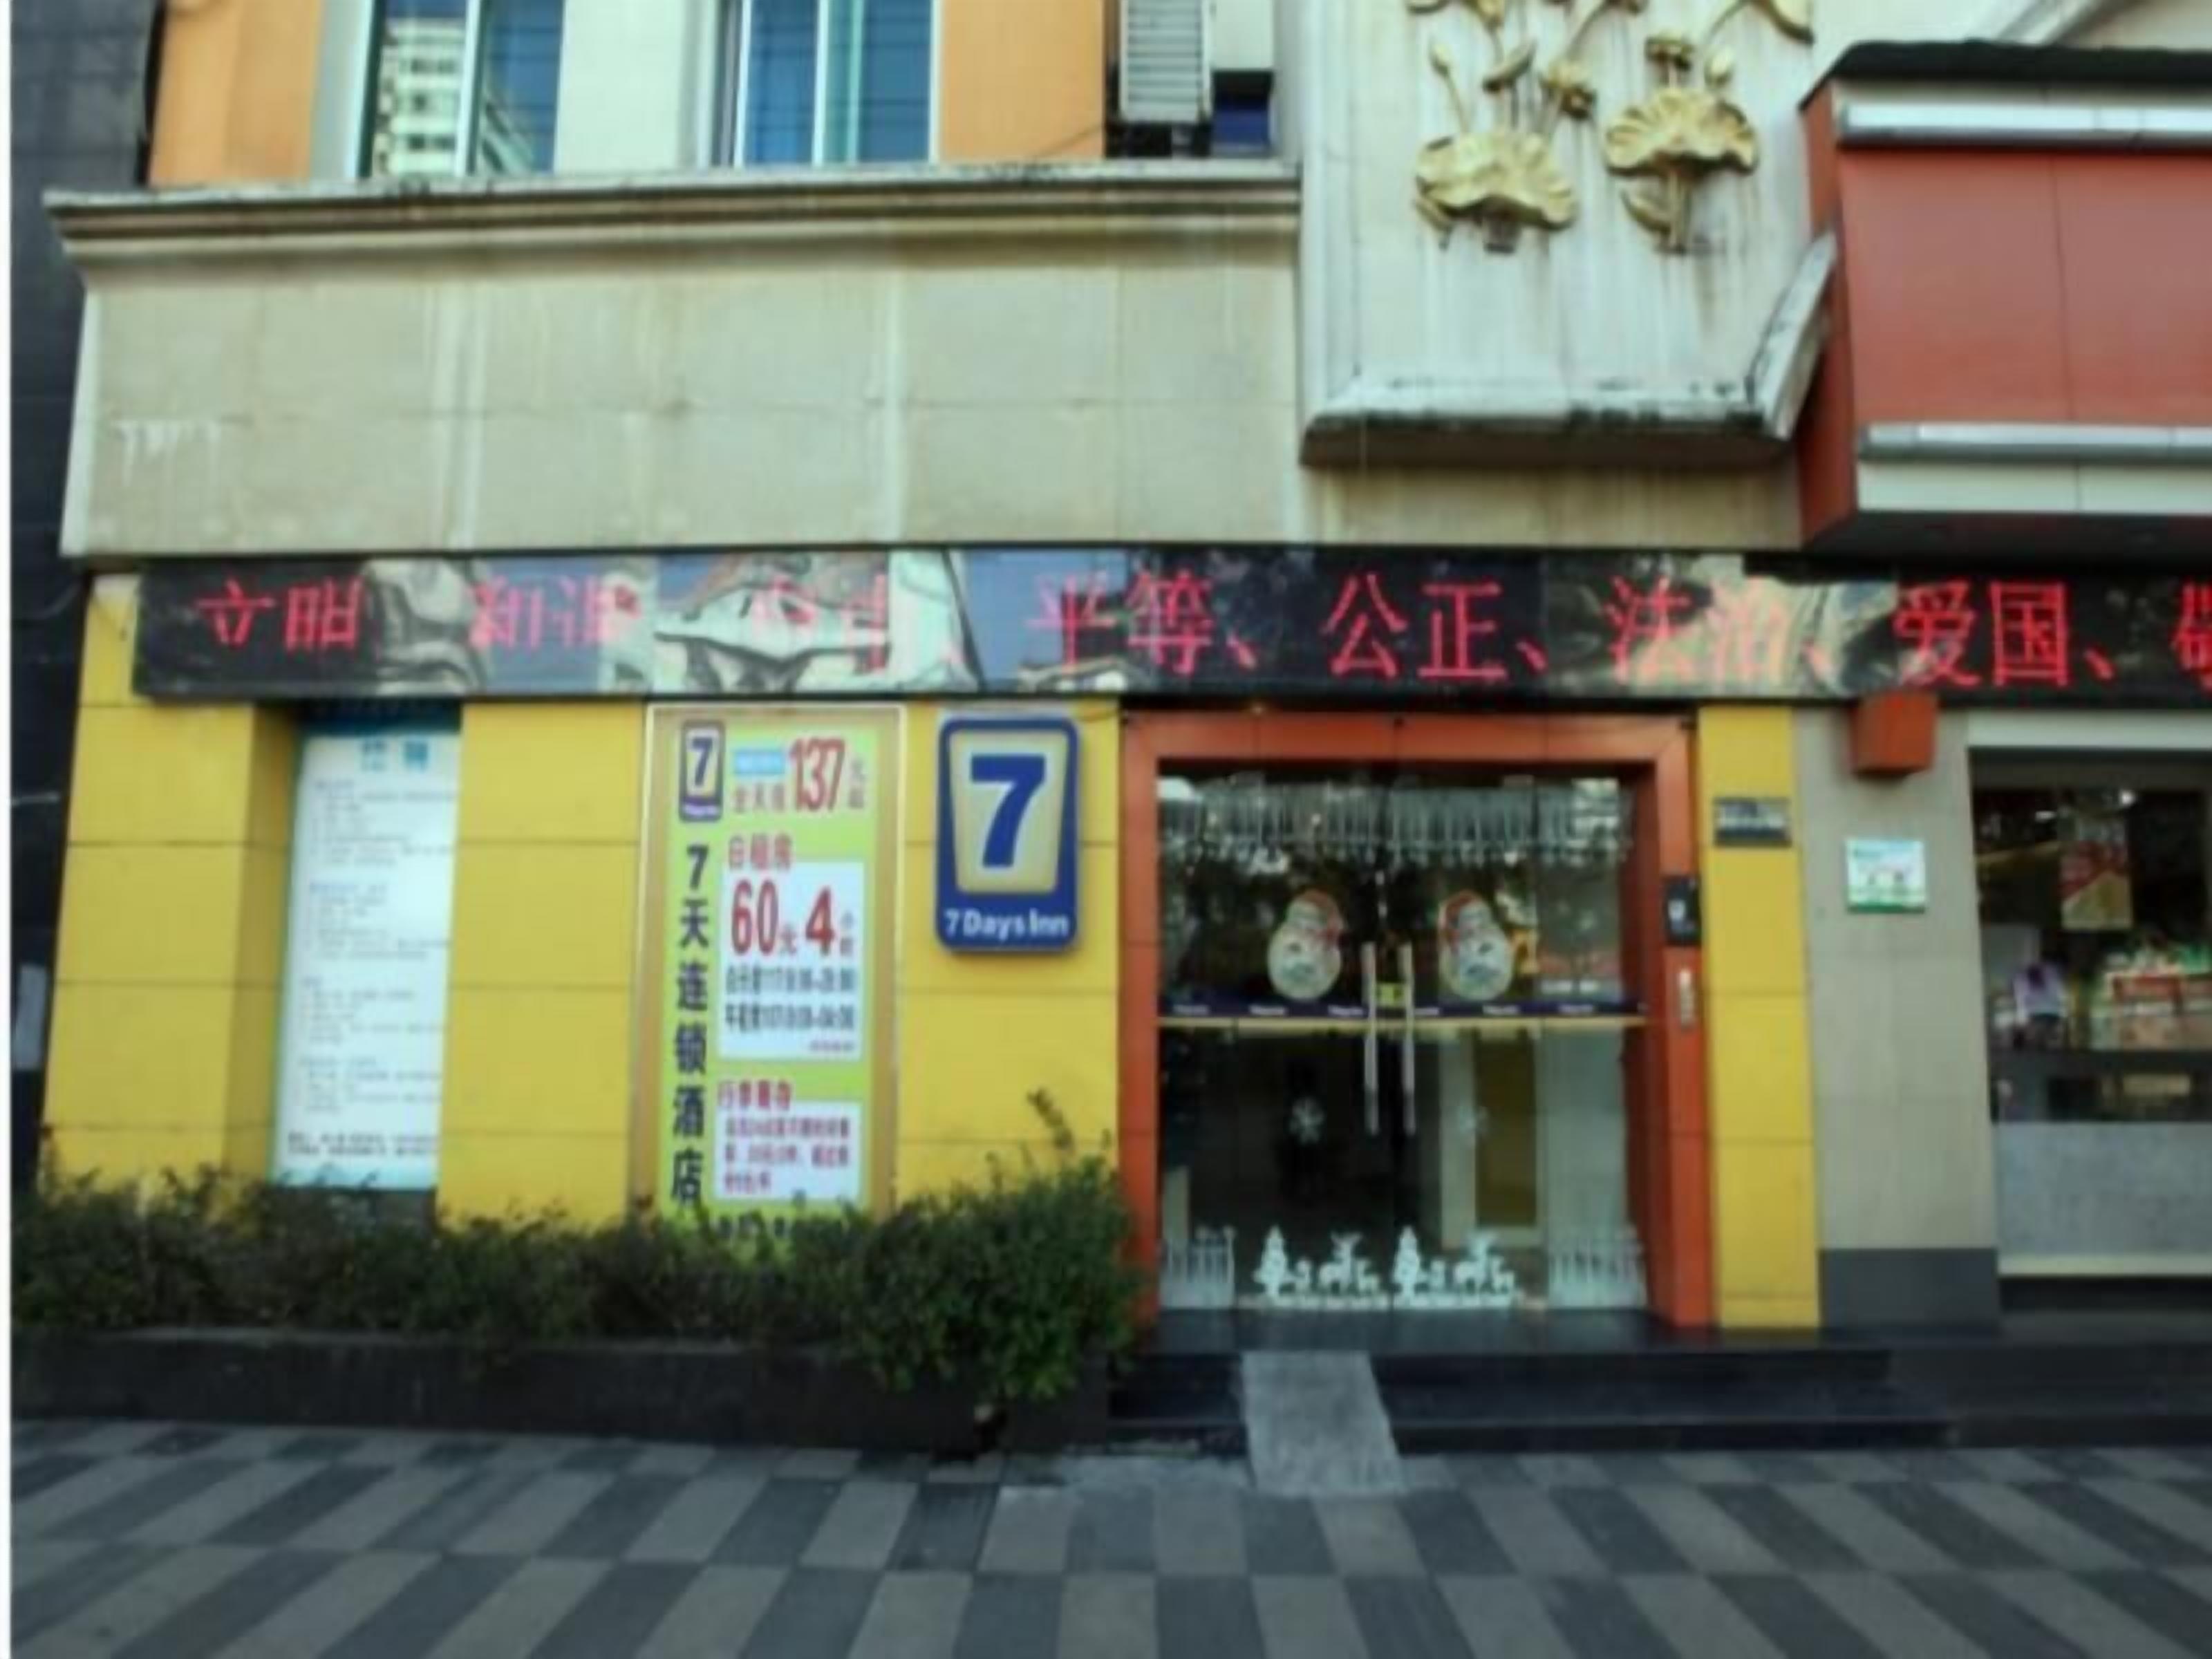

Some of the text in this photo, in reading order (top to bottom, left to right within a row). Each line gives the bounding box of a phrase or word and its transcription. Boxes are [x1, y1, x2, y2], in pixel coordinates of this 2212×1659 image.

[691, 737, 714, 787] 7
[971, 754, 1047, 868] 7
[963, 909, 1025, 941] Days
[1029, 908, 1070, 937] Inn
[671, 843, 710, 1204] 7天连锁酒店
